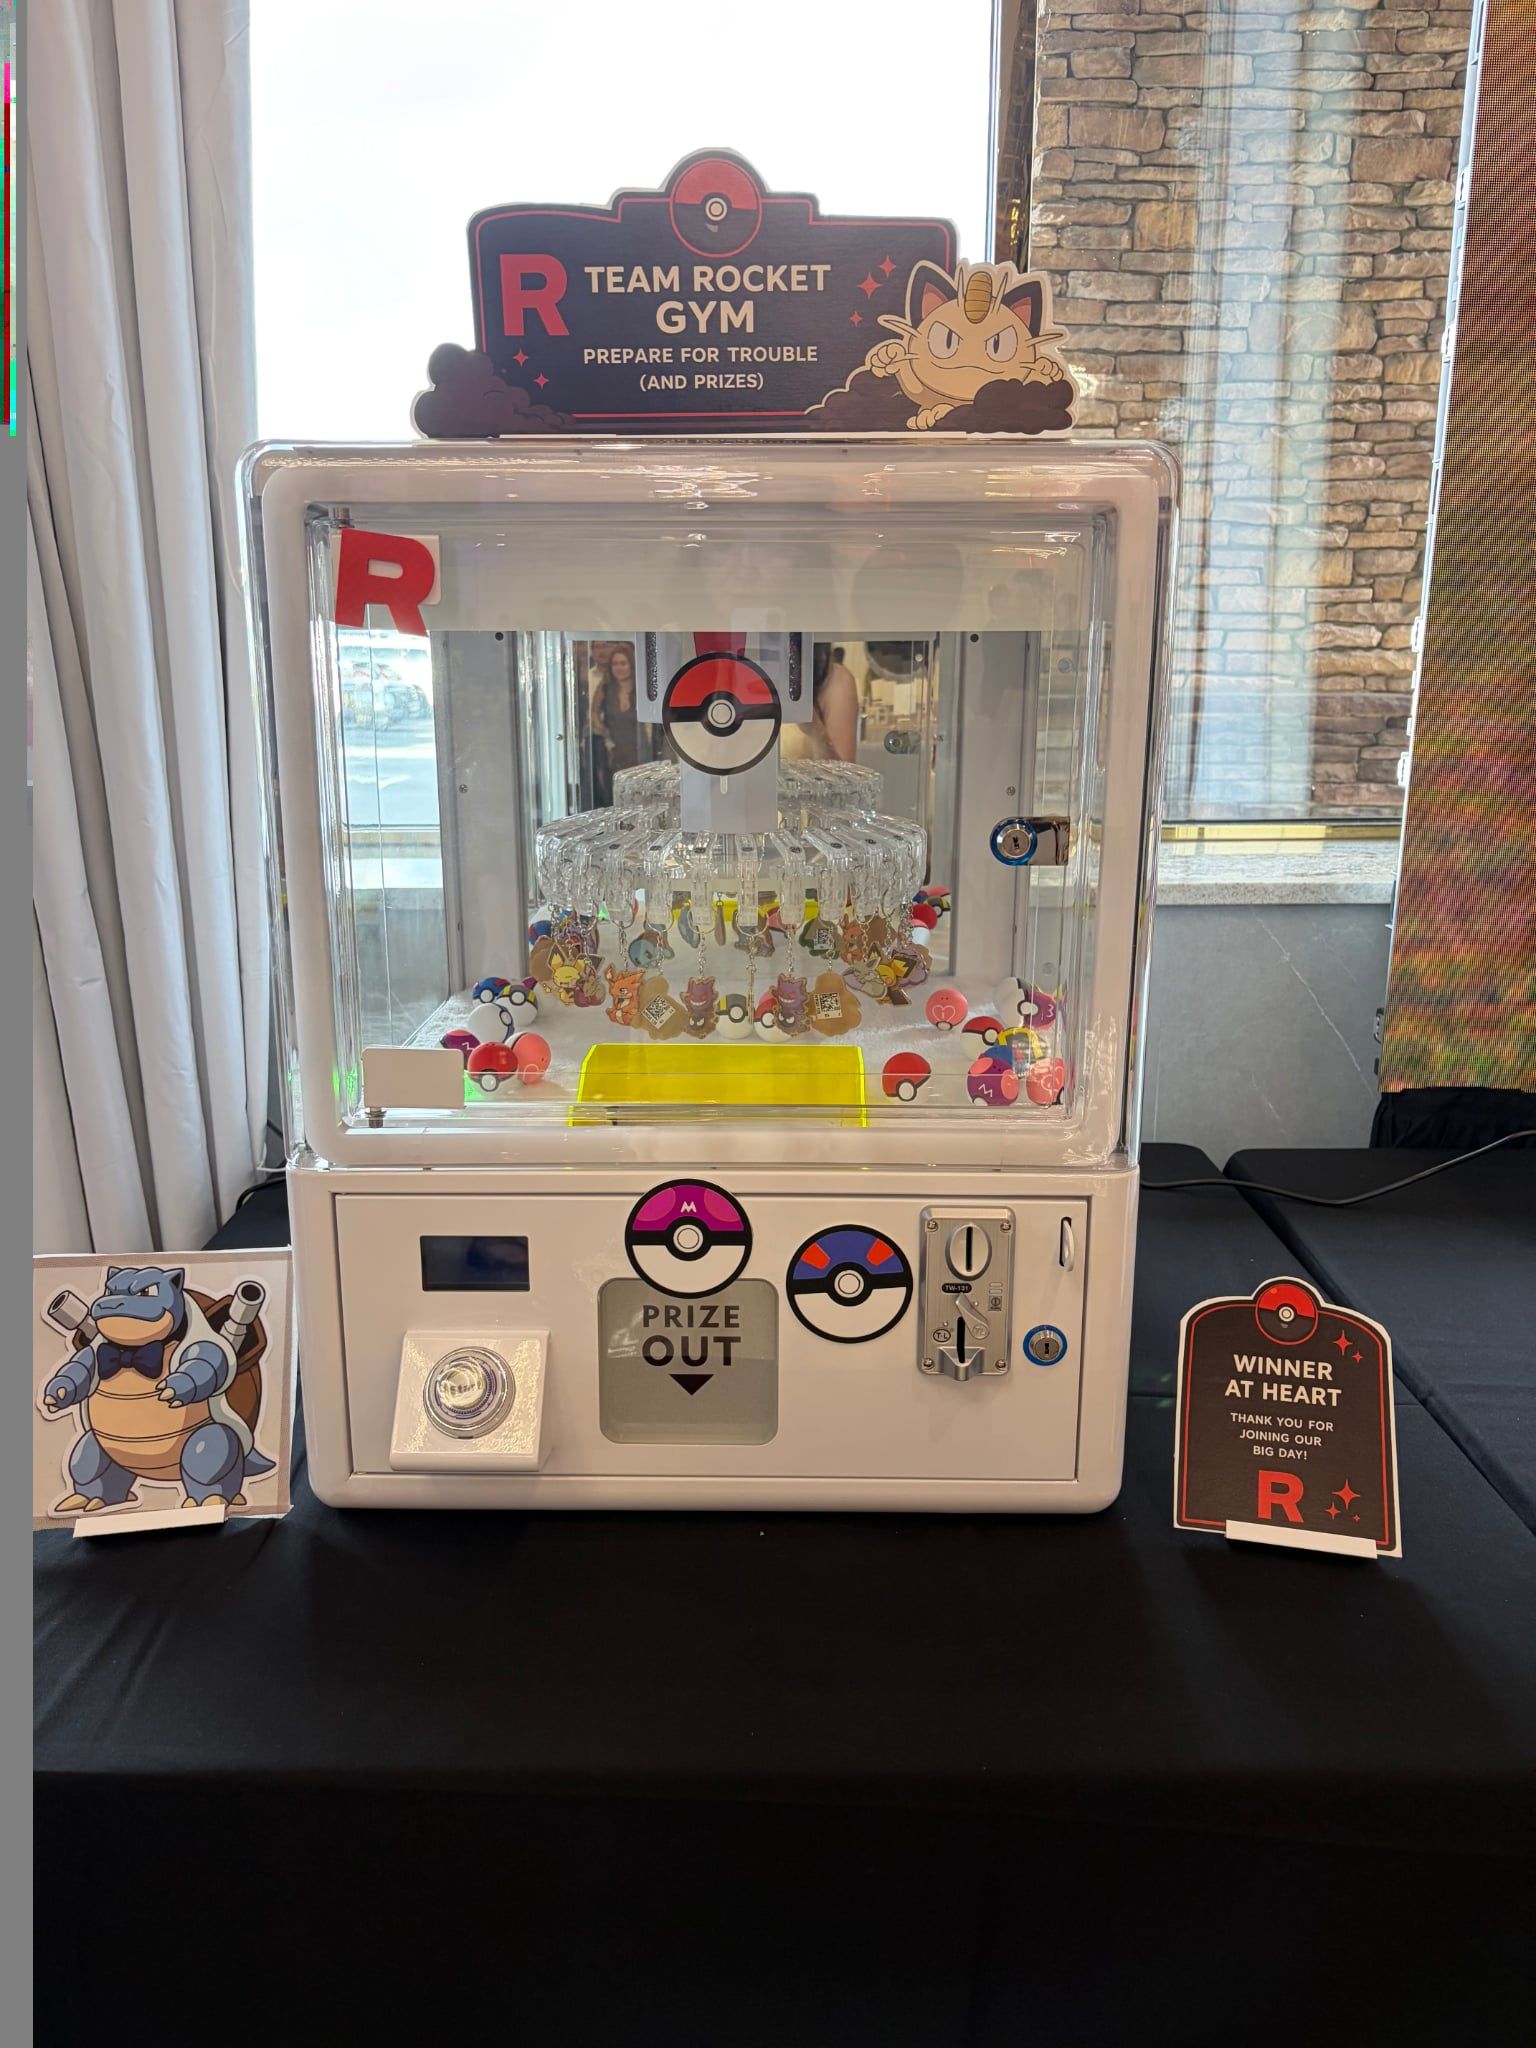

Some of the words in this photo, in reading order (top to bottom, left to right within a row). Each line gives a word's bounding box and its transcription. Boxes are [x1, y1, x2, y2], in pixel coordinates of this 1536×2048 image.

[584, 265, 680, 293] TEAM
[693, 264, 832, 292] ROCKET
[500, 254, 570, 337] R
[655, 300, 755, 334] GYM
[583, 347, 674, 364] PREPARE
[680, 347, 720, 363] FOR
[727, 346, 819, 362] TROUBLE
[639, 373, 688, 392] (AND
[694, 372, 764, 391] PRIZES)
[335, 527, 435, 637] R
[680, 1201, 697, 1213] M
[642, 1305, 740, 1328] PRIZE
[642, 1334, 741, 1367] OUT
[1233, 1354, 1333, 1381] WINNER
[1224, 1379, 1254, 1399] AT
[1262, 1383, 1342, 1407] HEART
[1230, 1412, 1272, 1426] THANK
[1276, 1417, 1303, 1429] YOU
[1308, 1420, 1334, 1432] FOR
[1240, 1429, 1290, 1443] JOINING
[1294, 1434, 1322, 1446] OUR
[1253, 1445, 1274, 1457] BIG
[1278, 1448, 1308, 1460] DAY!
[1257, 1469, 1304, 1523] R
